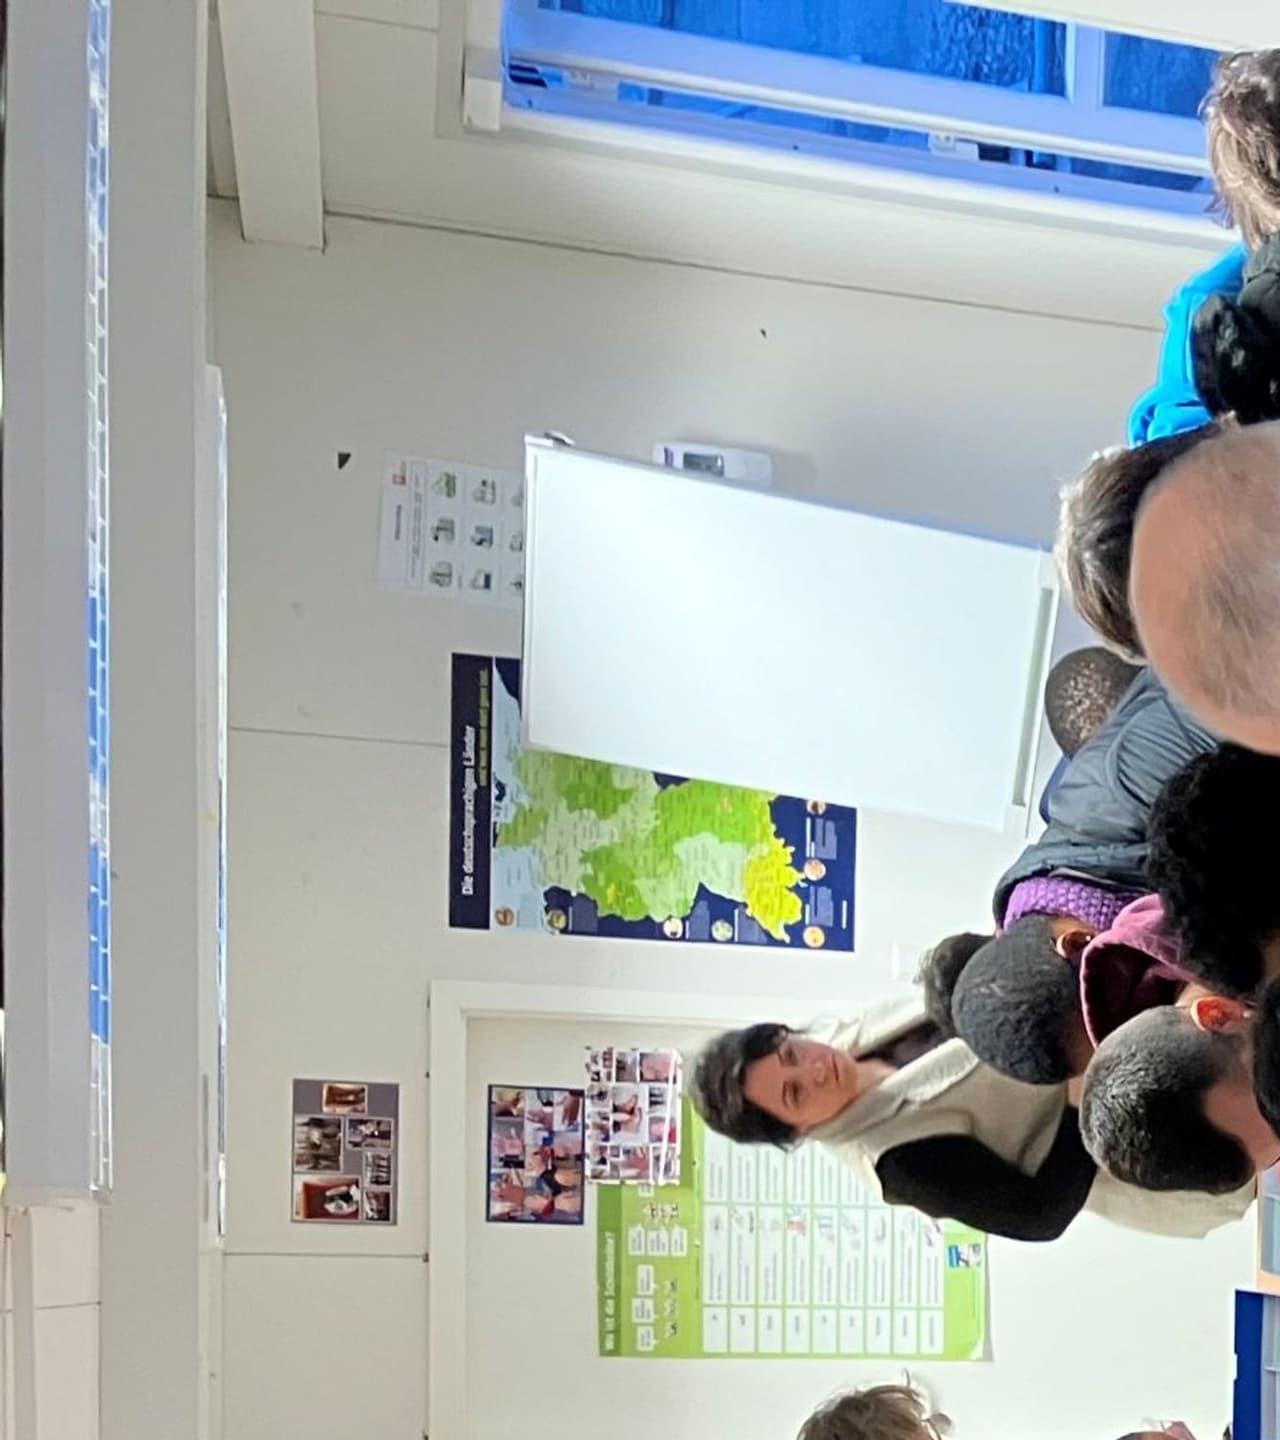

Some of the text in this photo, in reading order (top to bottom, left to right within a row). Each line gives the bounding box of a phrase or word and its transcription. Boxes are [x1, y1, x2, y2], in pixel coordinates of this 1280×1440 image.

[461, 724, 476, 895] Die deutschsprachigen Länder
